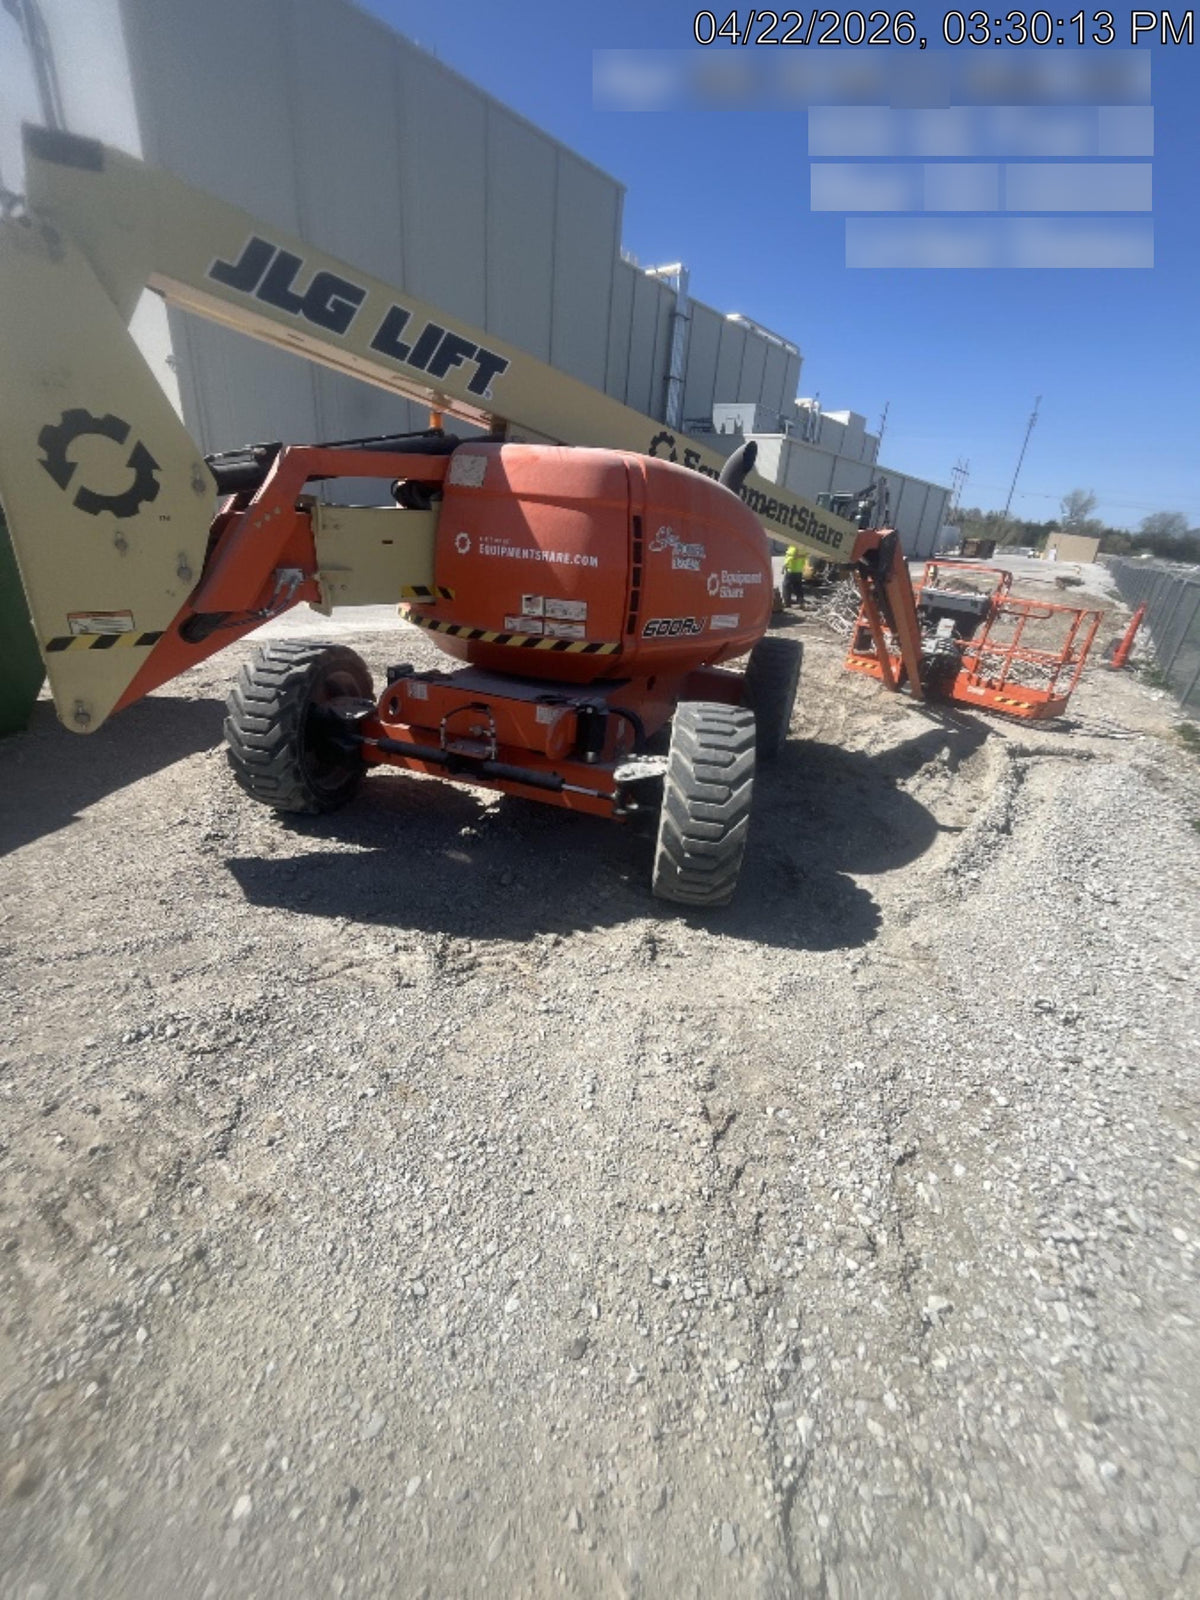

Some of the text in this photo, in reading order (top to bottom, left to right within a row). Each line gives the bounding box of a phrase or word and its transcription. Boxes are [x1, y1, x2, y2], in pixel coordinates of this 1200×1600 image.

[207, 235, 510, 397] JLG LIFT
[479, 543, 599, 568] EQUIPMENTSHARE.COM
